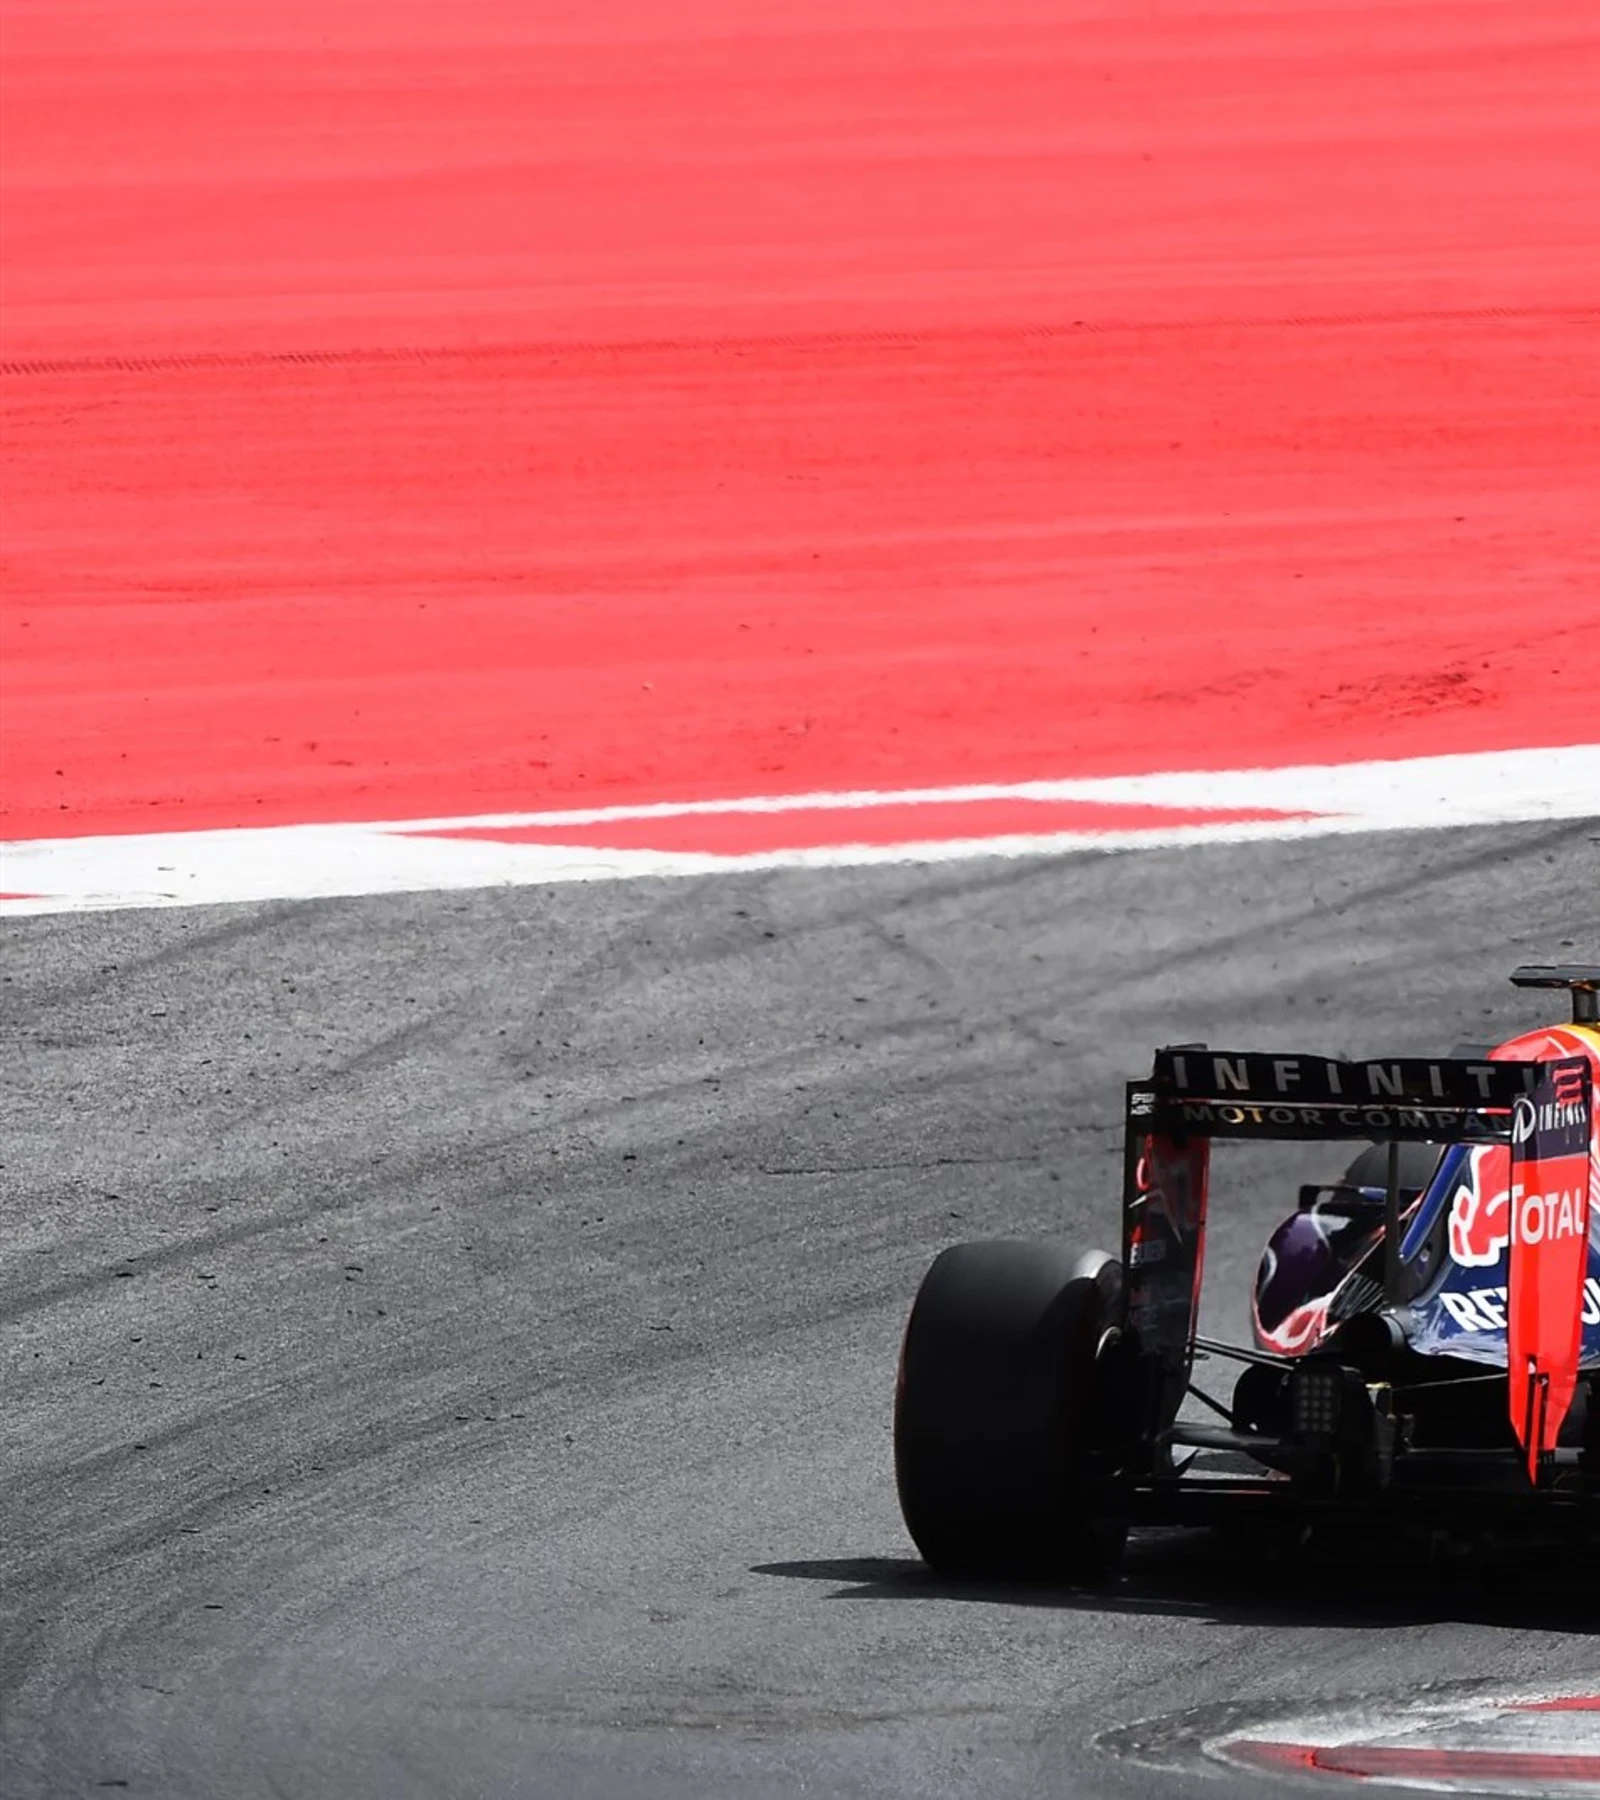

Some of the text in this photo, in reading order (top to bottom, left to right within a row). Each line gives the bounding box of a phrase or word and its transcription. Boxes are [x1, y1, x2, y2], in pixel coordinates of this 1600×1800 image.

[1172, 1055, 1535, 1098] INFINITI
[1184, 1103, 1324, 1126] MOTOR
[1338, 1106, 1512, 1131] COMPAN
[1511, 1183, 1585, 1246] TOTAL
